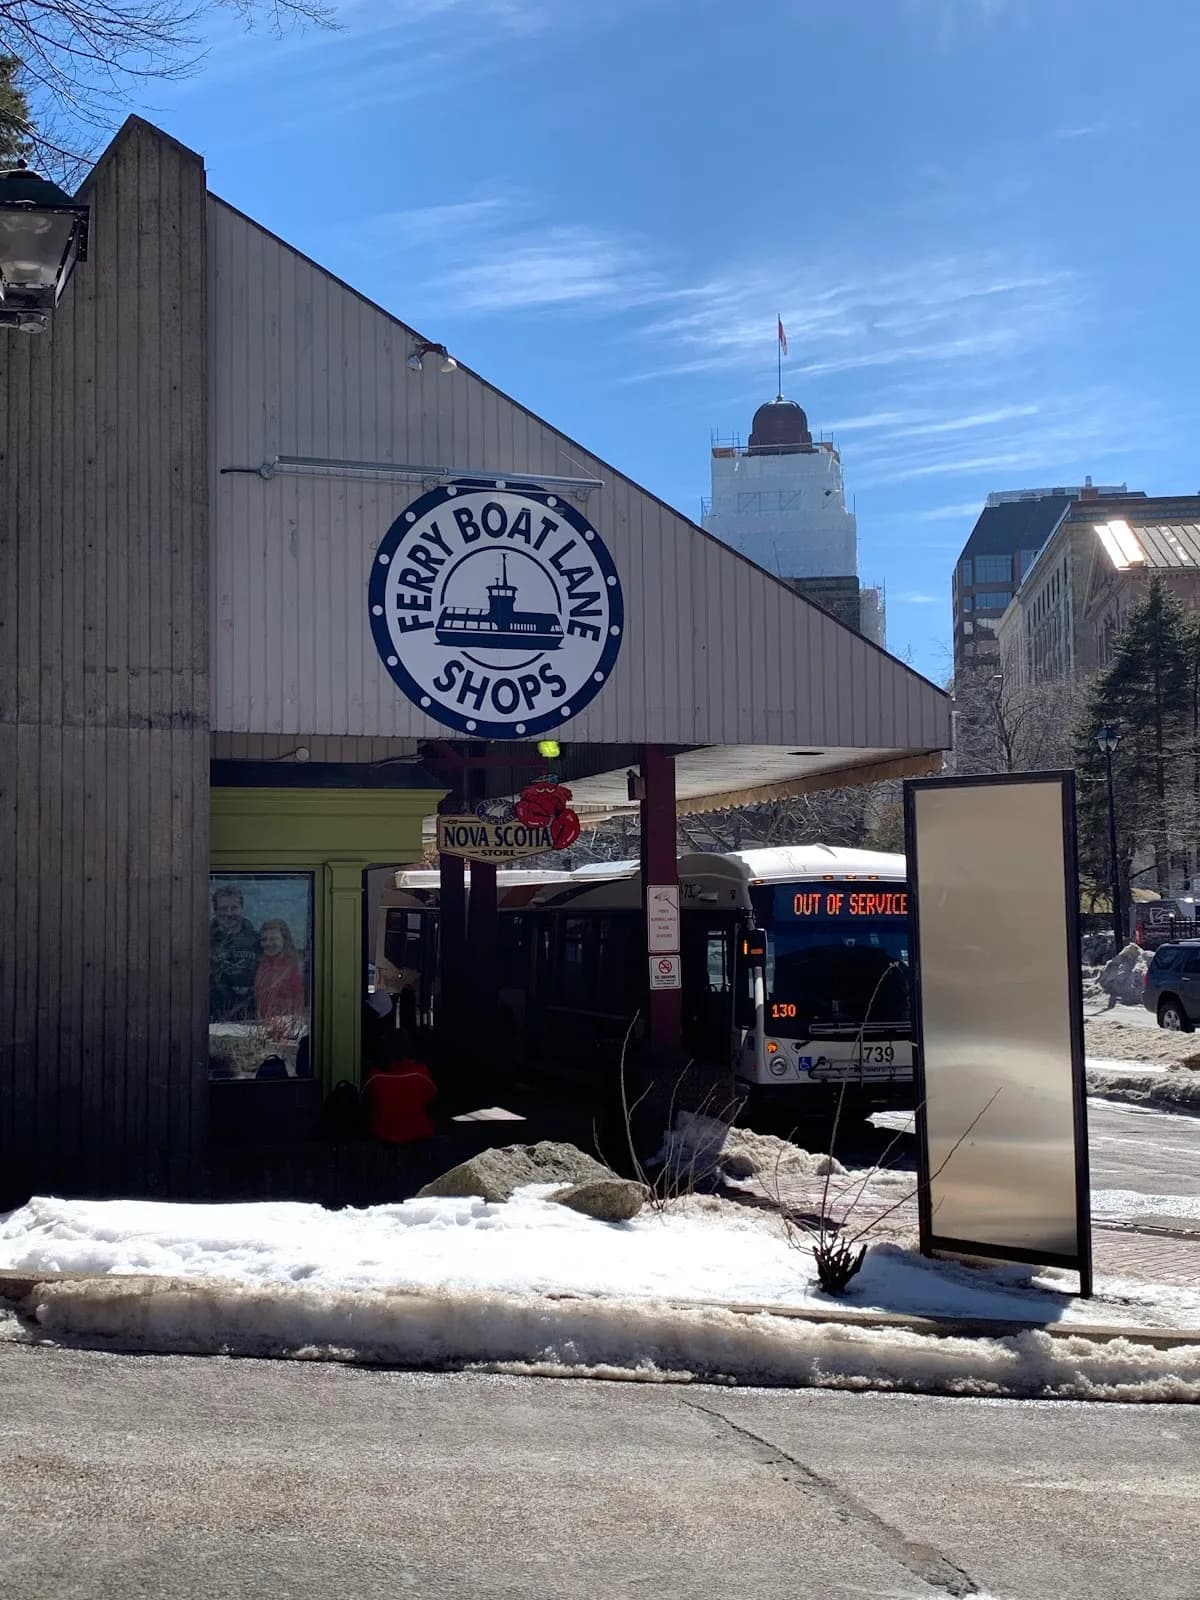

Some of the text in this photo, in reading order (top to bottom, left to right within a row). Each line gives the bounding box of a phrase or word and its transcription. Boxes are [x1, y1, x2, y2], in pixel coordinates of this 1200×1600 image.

[396, 501, 603, 642] FERRY BOAT LANE
[432, 659, 567, 715] SHOPS
[443, 825, 553, 847] NOVA SCOTIA
[480, 849, 516, 857] STORE
[793, 893, 908, 915] OUT OF SERVICE
[772, 1003, 797, 1018] 130
[864, 1046, 895, 1063] 739
